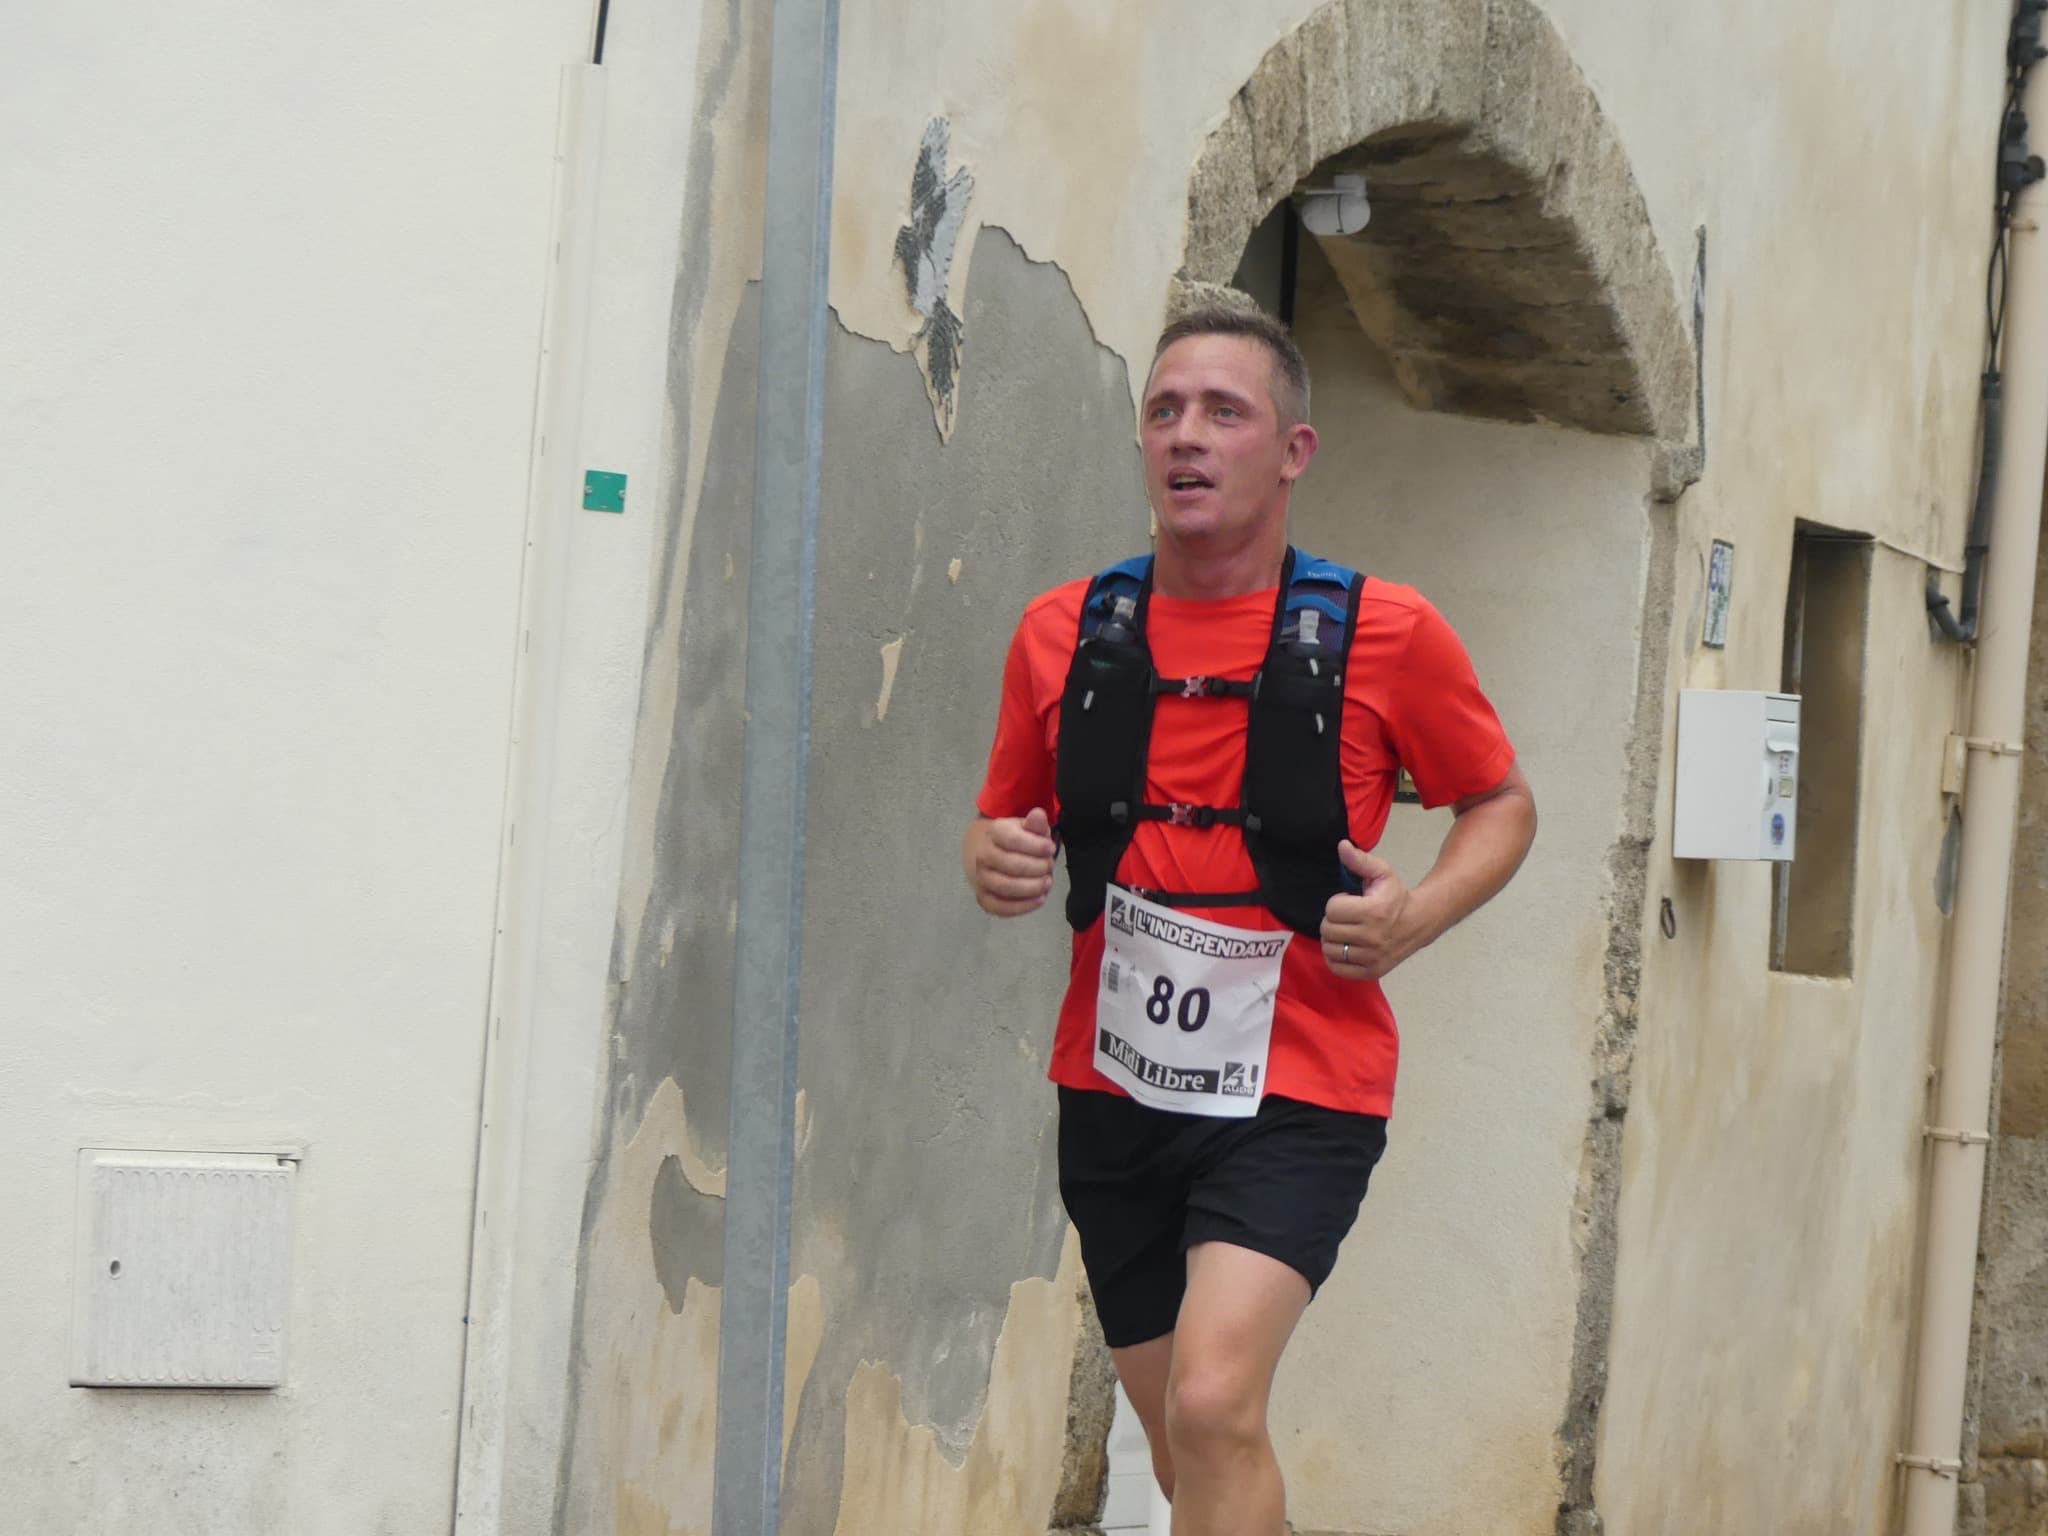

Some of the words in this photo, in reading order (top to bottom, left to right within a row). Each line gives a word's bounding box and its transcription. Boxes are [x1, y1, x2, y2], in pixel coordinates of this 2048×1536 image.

[1146, 975, 1210, 1032] 80
[1108, 1034, 1141, 1075] Midi
[1142, 1059, 1205, 1091] Libre
